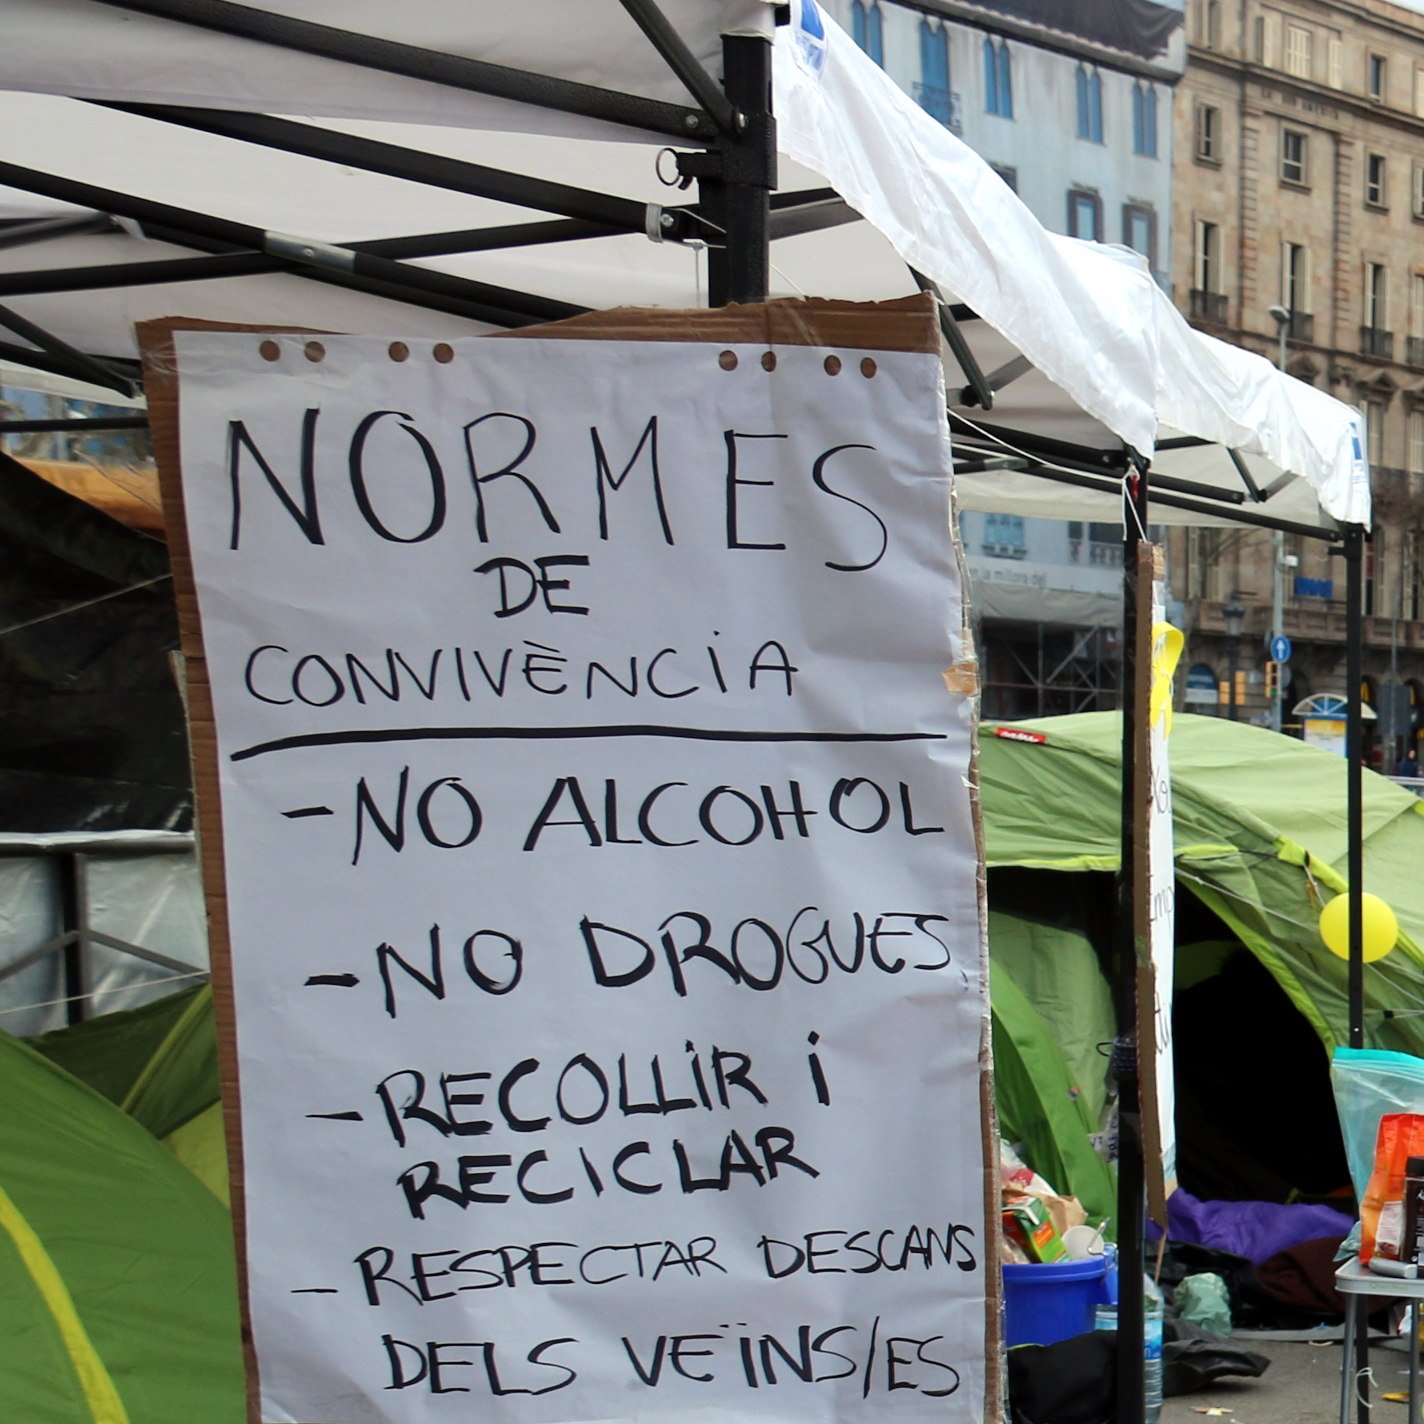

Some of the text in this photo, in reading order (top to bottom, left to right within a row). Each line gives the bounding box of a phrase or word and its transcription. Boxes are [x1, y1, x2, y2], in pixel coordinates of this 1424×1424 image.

[229, 407, 891, 572] NORMES
[475, 554, 592, 618] DE
[523, 776, 948, 851] ALCOHOL
[579, 906, 953, 996] DROGUES
[806, 1031, 832, 1107] i
[396, 1125, 820, 1220] RECICLAR
[760, 1223, 978, 1280] DESCANS
[384, 1314, 962, 1402] DELS VEÏNS/ES
